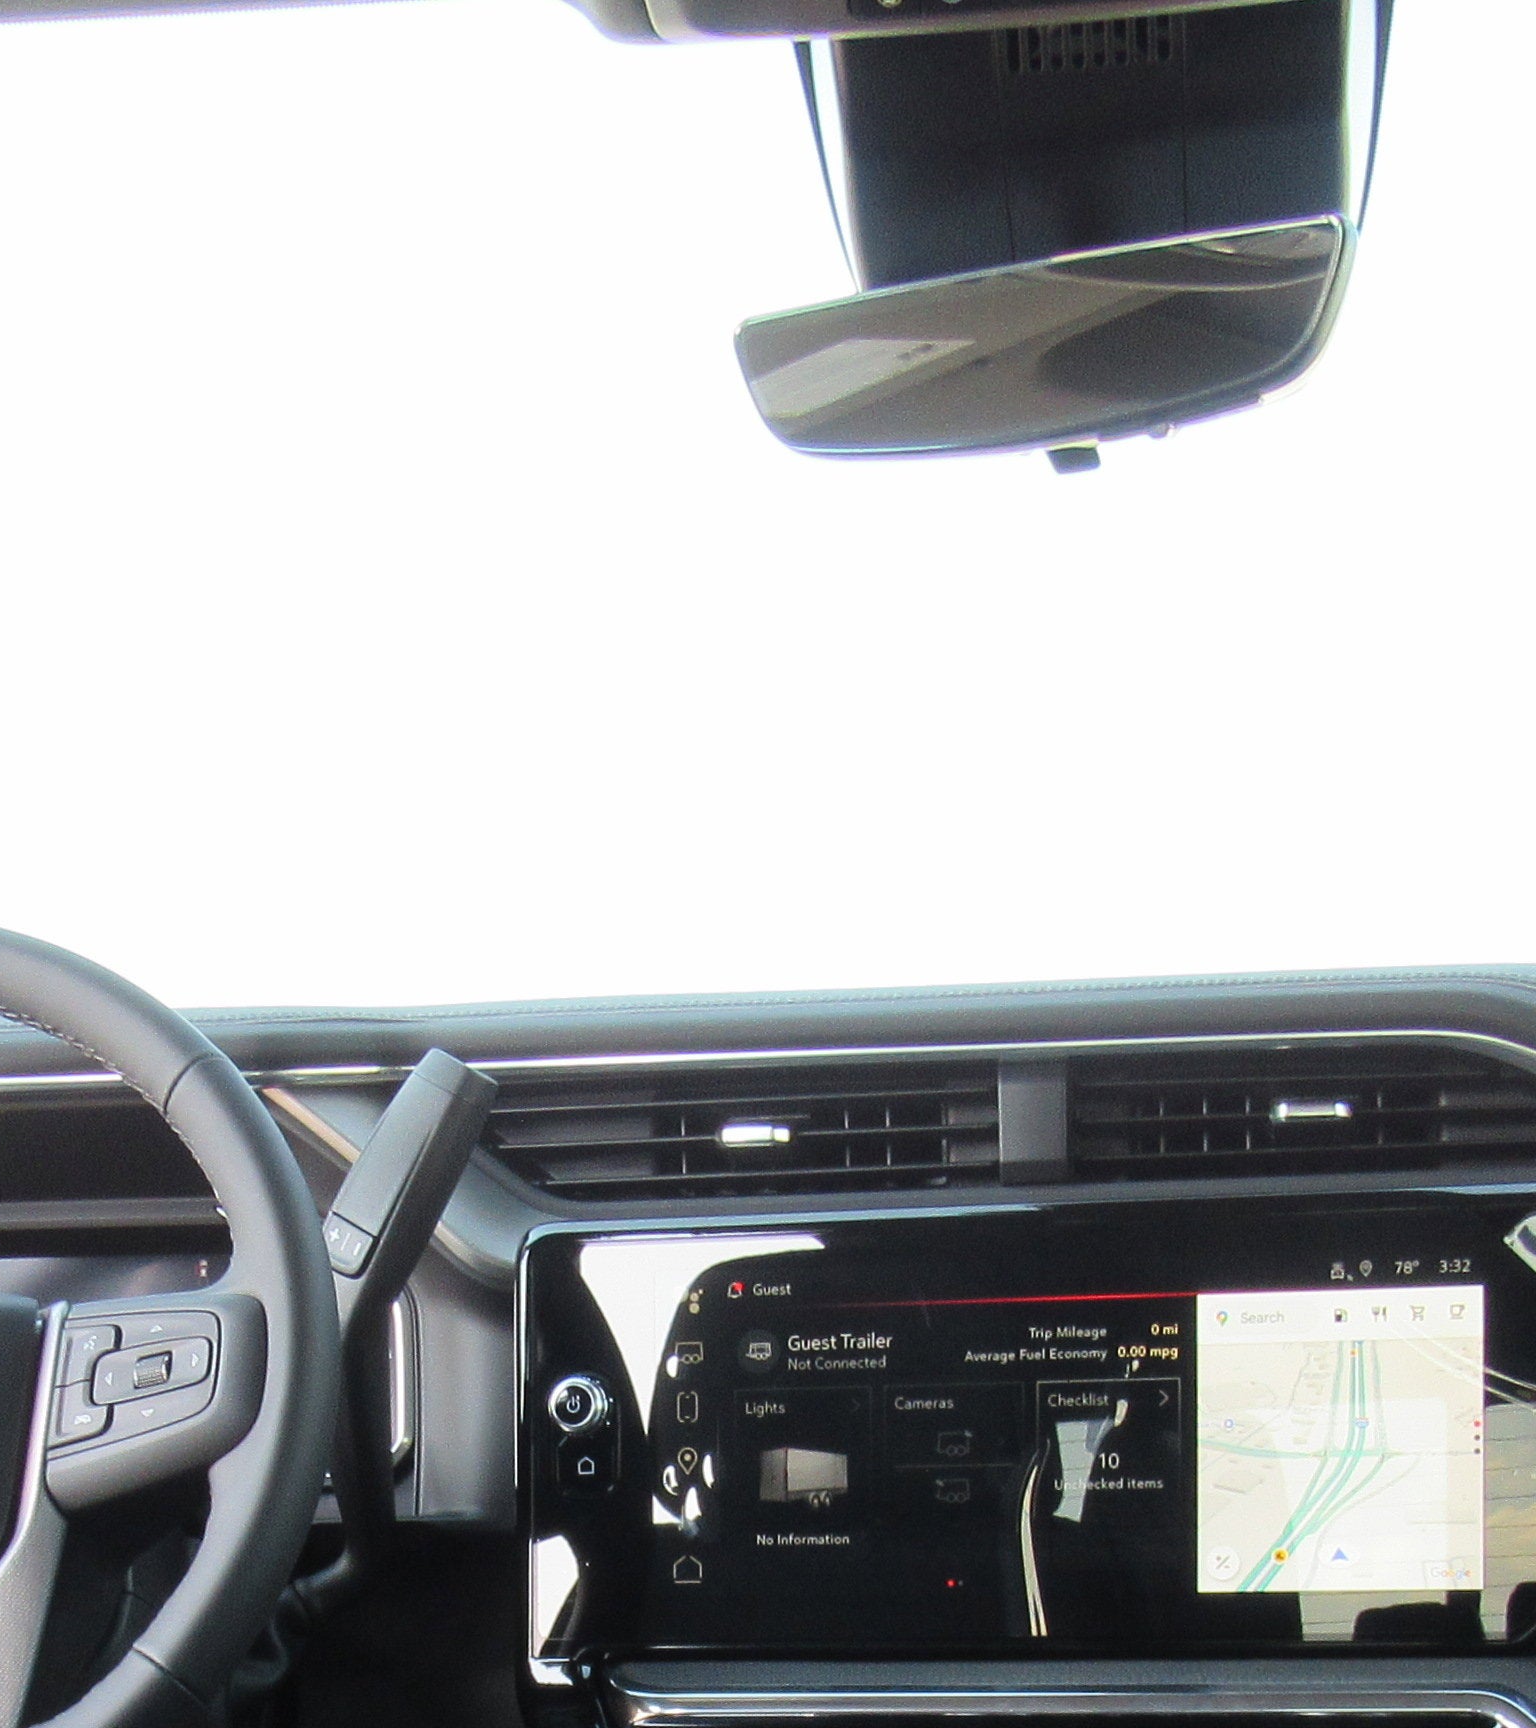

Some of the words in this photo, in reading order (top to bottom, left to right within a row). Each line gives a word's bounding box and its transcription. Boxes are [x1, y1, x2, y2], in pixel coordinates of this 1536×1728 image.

[1438, 1259, 1471, 1273] 3:32
[752, 1283, 792, 1297] Guest
[1240, 1311, 1285, 1324] Search
[1029, 1327, 1053, 1341] Trip
[1056, 1325, 1108, 1340] Mileage
[1150, 1324, 1159, 1335] 0
[1163, 1323, 1179, 1335] mi
[787, 1335, 837, 1351] Guest
[840, 1333, 893, 1350] Trailer
[964, 1350, 1015, 1365] Average
[1019, 1348, 1046, 1360] Fuel
[1049, 1348, 1108, 1362] Economy
[1117, 1346, 1147, 1357] 0.00
[1150, 1347, 1179, 1361] mpg
[787, 1357, 811, 1371] Not
[814, 1355, 888, 1370] Connected
[894, 1397, 954, 1411] Cameras
[1047, 1393, 1109, 1407] Checklist
[744, 1401, 786, 1416] Lights
[1098, 1452, 1120, 1469] 10
[1127, 1478, 1164, 1490] items
[756, 1533, 774, 1546] No
[777, 1532, 850, 1546] Information
[1430, 1565, 1471, 1580] Google
